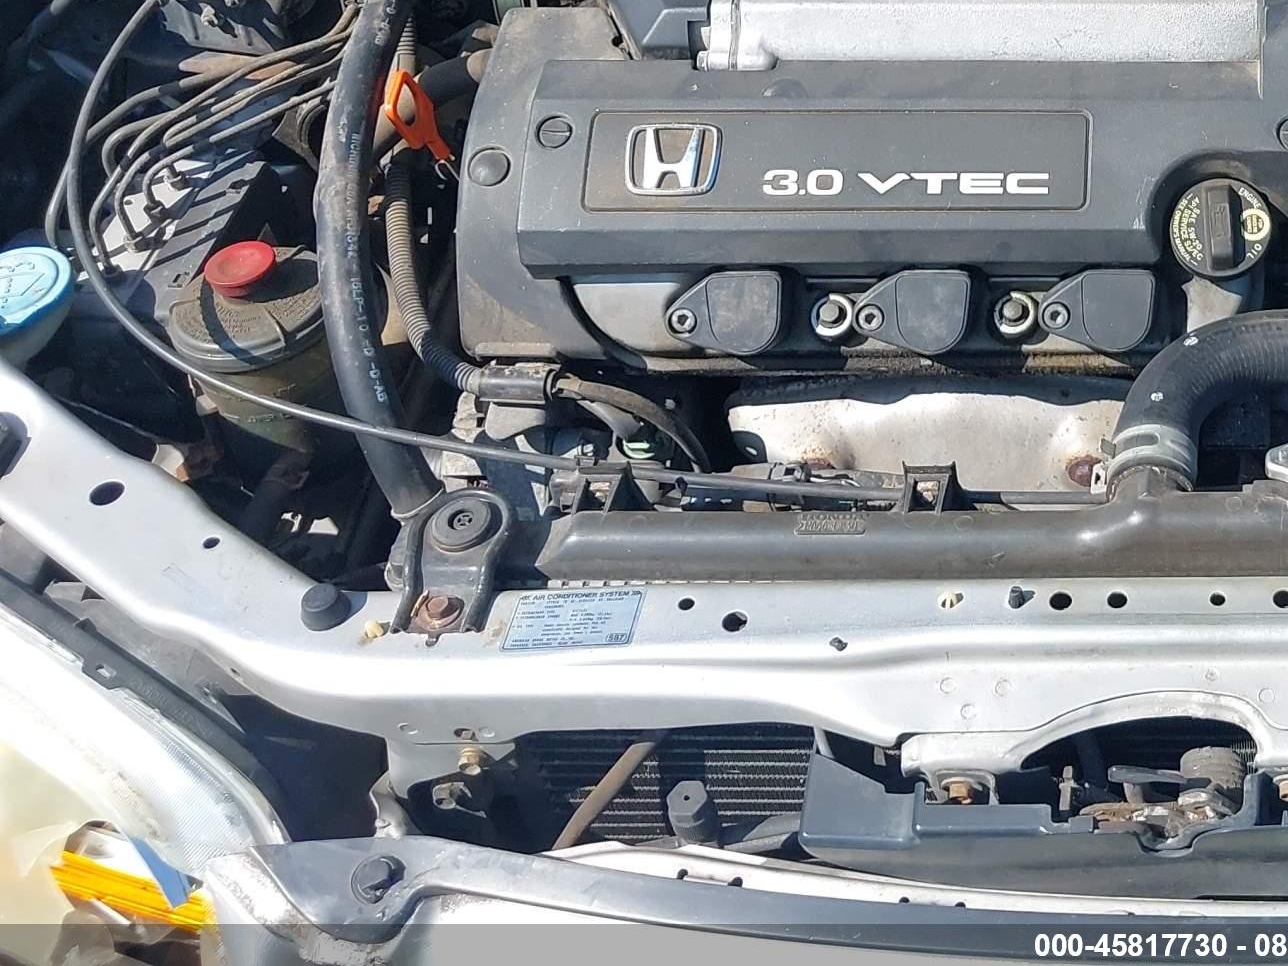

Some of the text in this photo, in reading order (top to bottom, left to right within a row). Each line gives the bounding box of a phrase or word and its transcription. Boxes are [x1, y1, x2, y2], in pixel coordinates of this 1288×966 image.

[762, 169, 1049, 196] 3.0 VTEC
[1238, 187, 1262, 209] ENGINE
[1179, 209, 1193, 240] SERVICE
[1187, 207, 1203, 251] SAE 5W-20
[1246, 243, 1262, 259] OIL
[547, 591, 598, 599] CONDITIONER
[599, 590, 630, 598] SYSTEM
